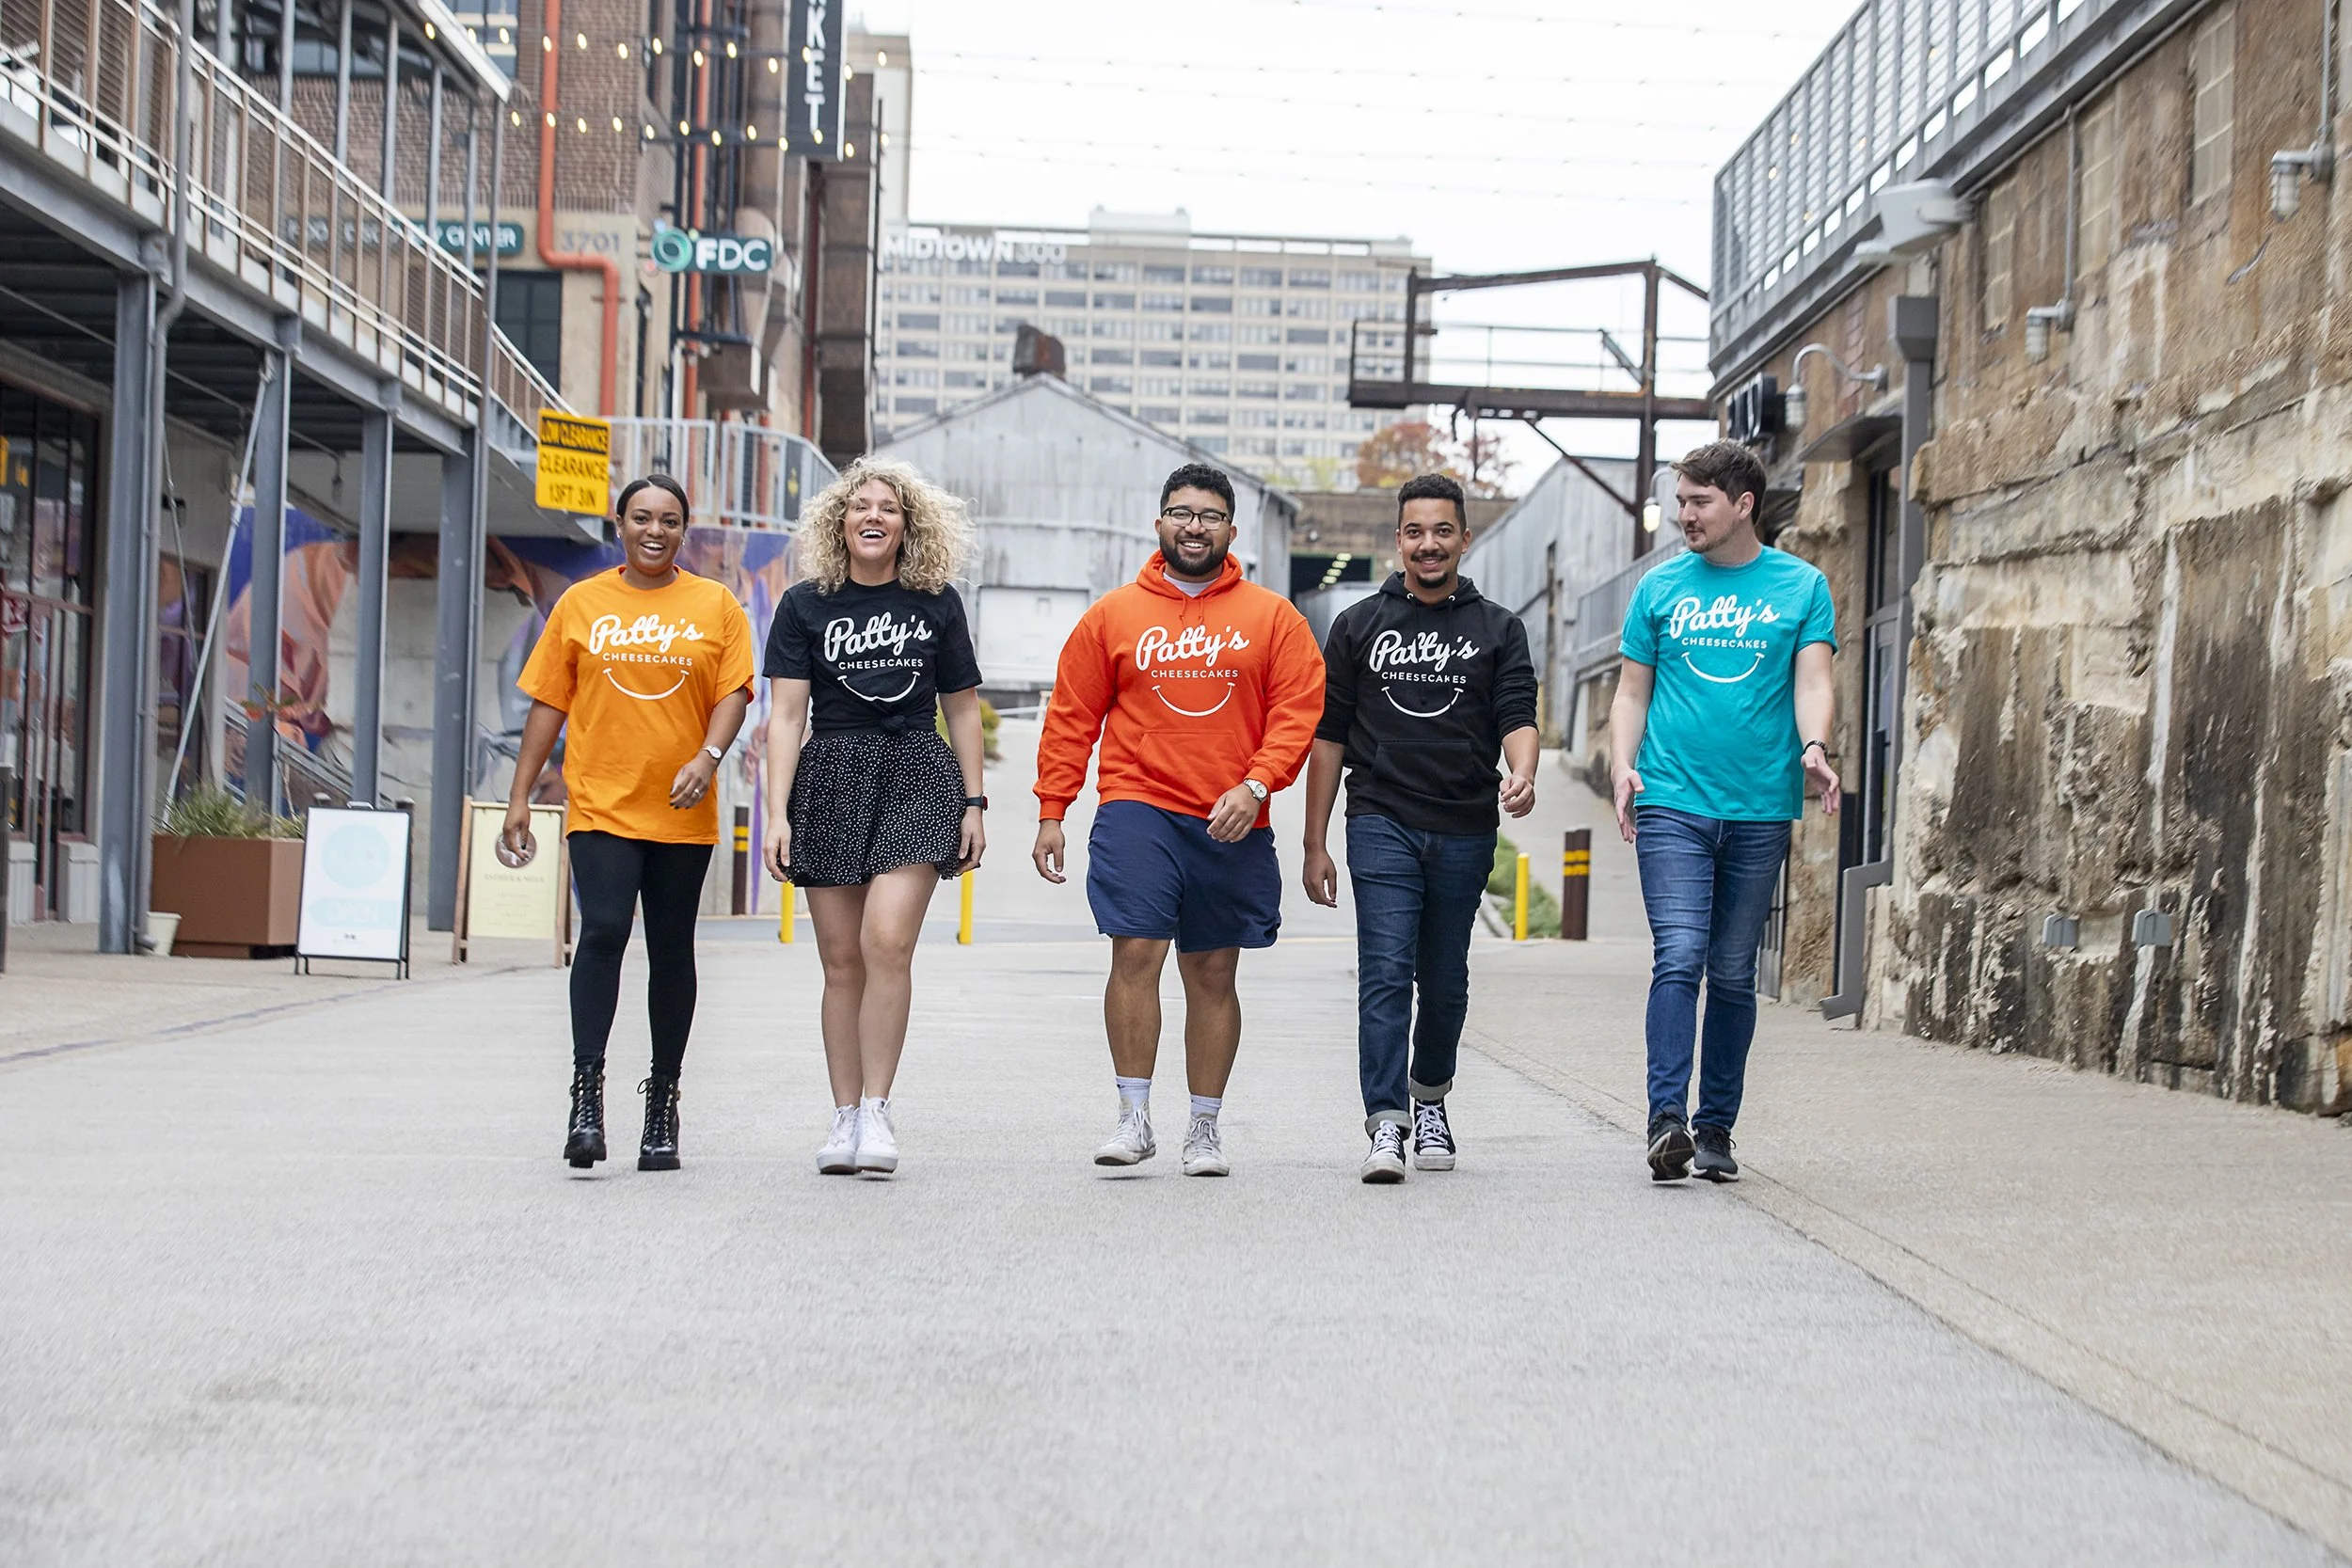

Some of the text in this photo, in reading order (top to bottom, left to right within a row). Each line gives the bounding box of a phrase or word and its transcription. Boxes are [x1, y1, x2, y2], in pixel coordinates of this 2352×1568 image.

[803, 0, 826, 136] KET
[696, 237, 768, 271] FDC
[883, 235, 1014, 262] MIDTOWN
[560, 422, 608, 452] CLEARANCE
[539, 451, 609, 483] CLEARANCE
[548, 483, 596, 508] 13FT 3IN
[1670, 594, 1780, 639] Patty's
[589, 614, 704, 655] Patty's
[824, 611, 932, 661] Patty's
[1136, 625, 1249, 671] Patty's
[1681, 638, 1768, 649] CHEESECAKES
[602, 653, 692, 666] CHEESECAKES
[838, 658, 923, 670] CHEESECAKES
[1369, 629, 1480, 673] Patty's
[1151, 669, 1238, 678] CHEESECAKES
[1381, 672, 1467, 684] CHEESECAKES
